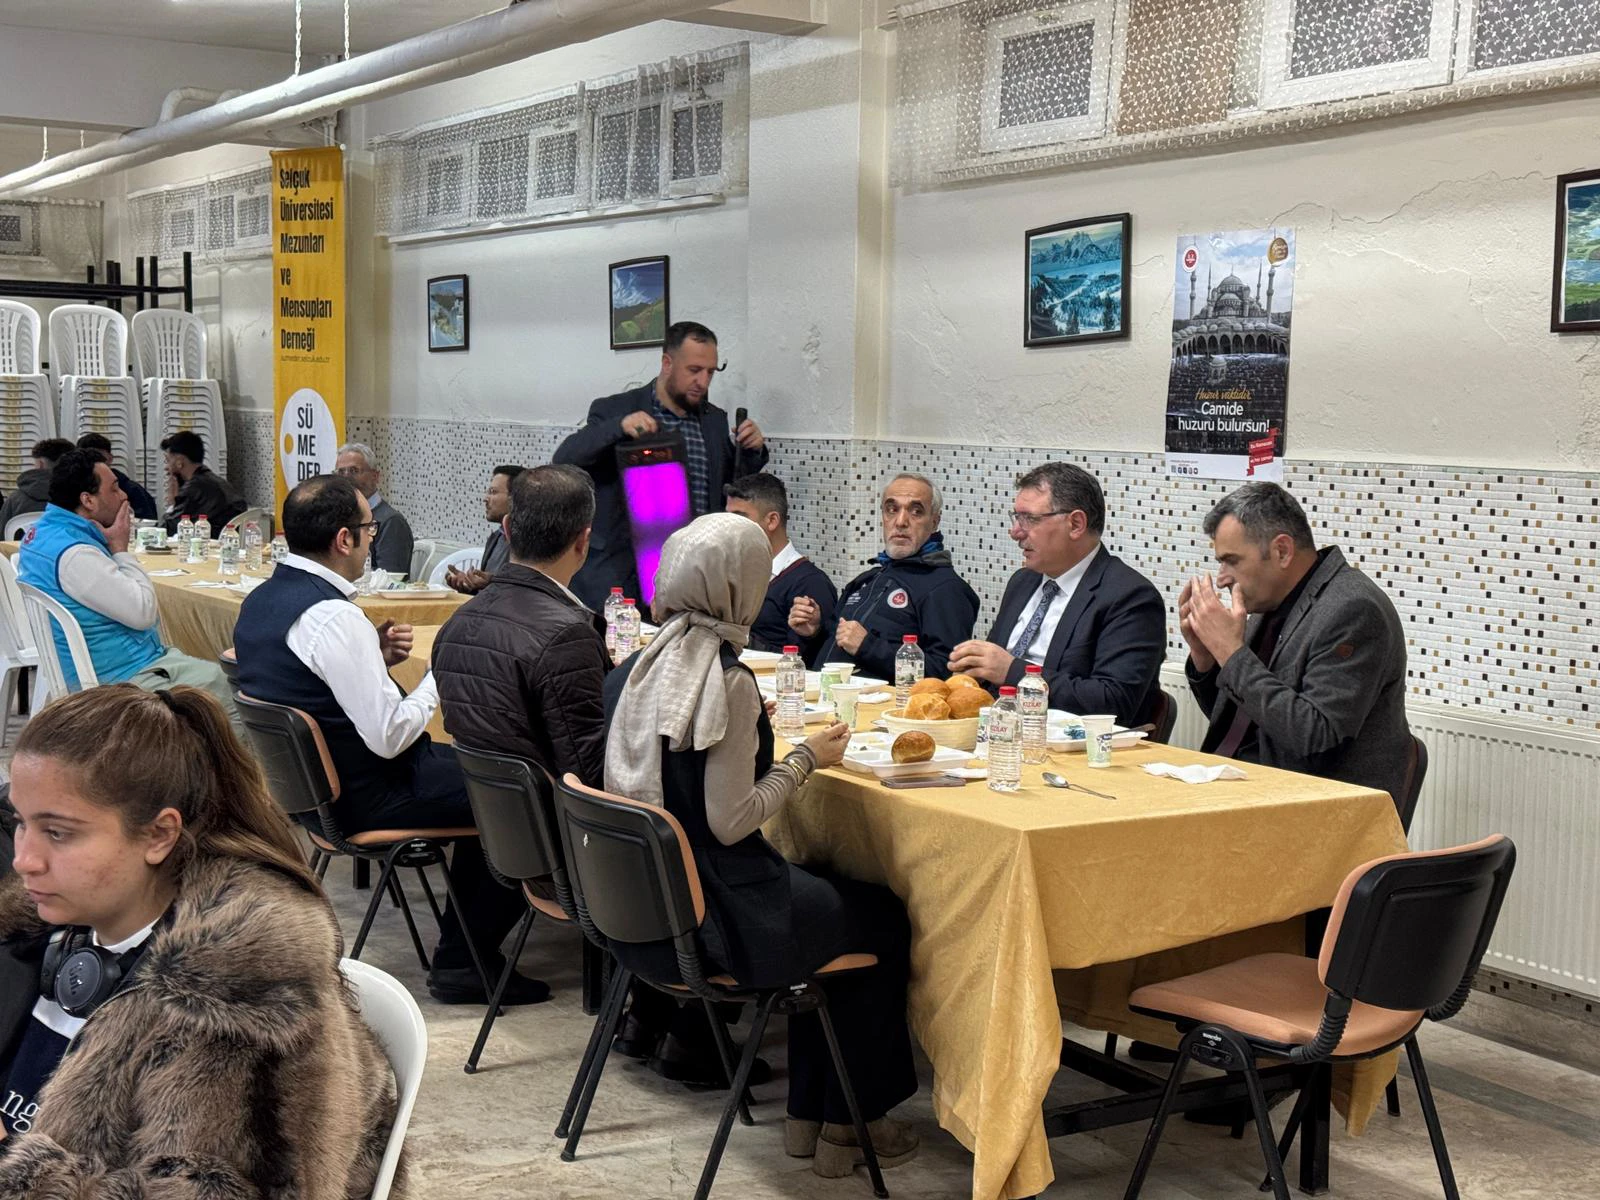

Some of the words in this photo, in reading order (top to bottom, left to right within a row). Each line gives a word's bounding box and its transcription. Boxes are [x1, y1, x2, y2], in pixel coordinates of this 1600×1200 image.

[280, 168, 310, 195] Selçuk
[280, 198, 333, 221] Üniversitesi
[280, 232, 325, 254] Mezunları
[280, 267, 291, 286] ve
[280, 297, 332, 321] Mensupları
[281, 328, 315, 352] Derneği
[297, 403, 313, 429] SÜ
[1201, 402, 1244, 416] Camide
[1178, 417, 1215, 430] huzuru
[1217, 417, 1270, 433] bulursun!
[297, 434, 316, 457] ME
